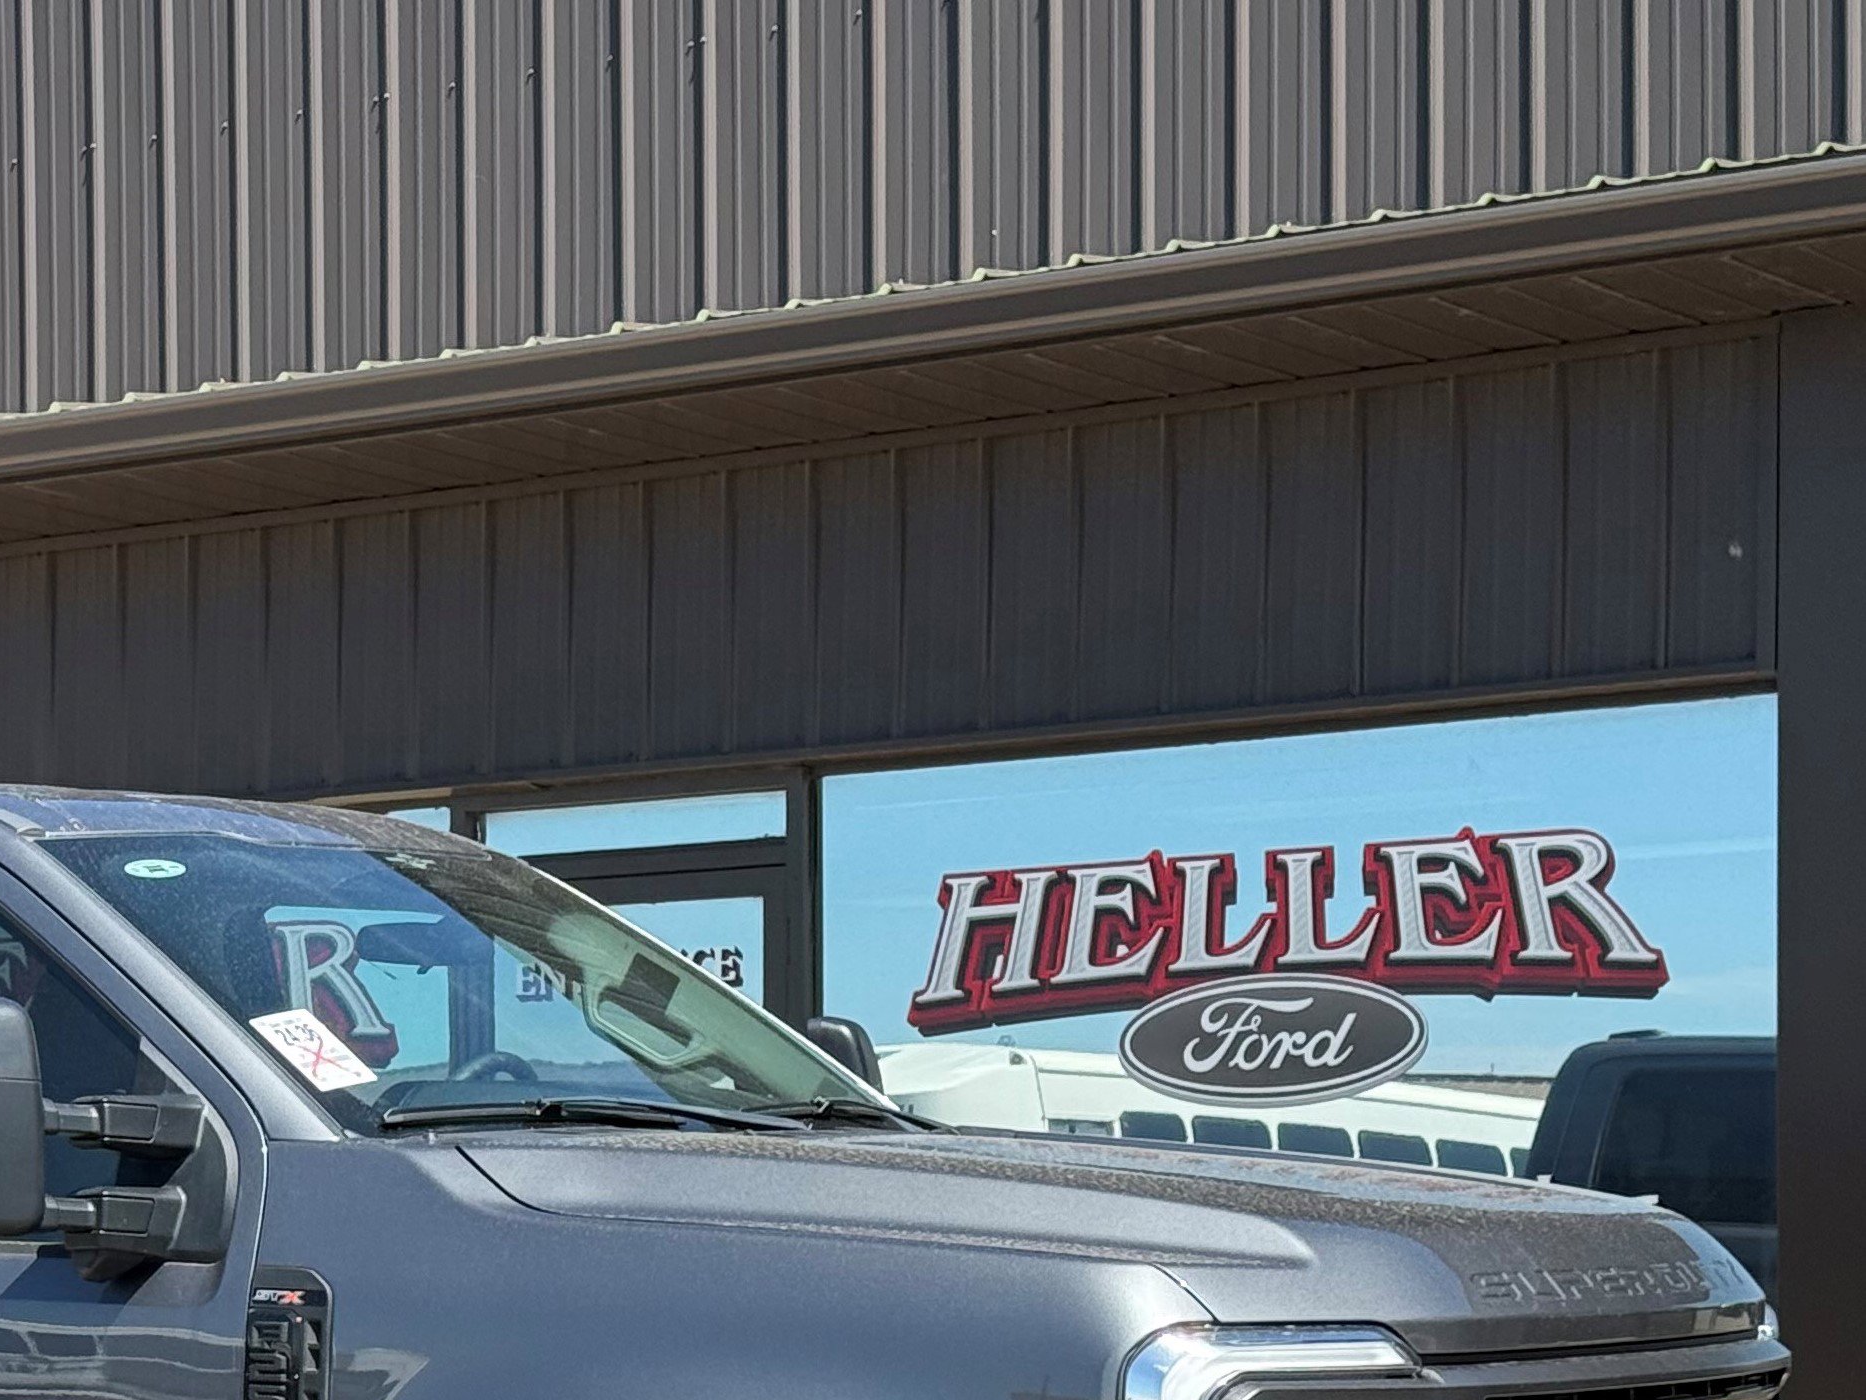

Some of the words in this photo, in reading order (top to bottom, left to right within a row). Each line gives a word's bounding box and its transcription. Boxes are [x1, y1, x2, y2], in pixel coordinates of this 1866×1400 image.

[909, 828, 1667, 1030] HELLER
[681, 945, 743, 987] CE
[1182, 995, 1356, 1073] Ford
[1470, 1267, 1653, 1305] SUPER
